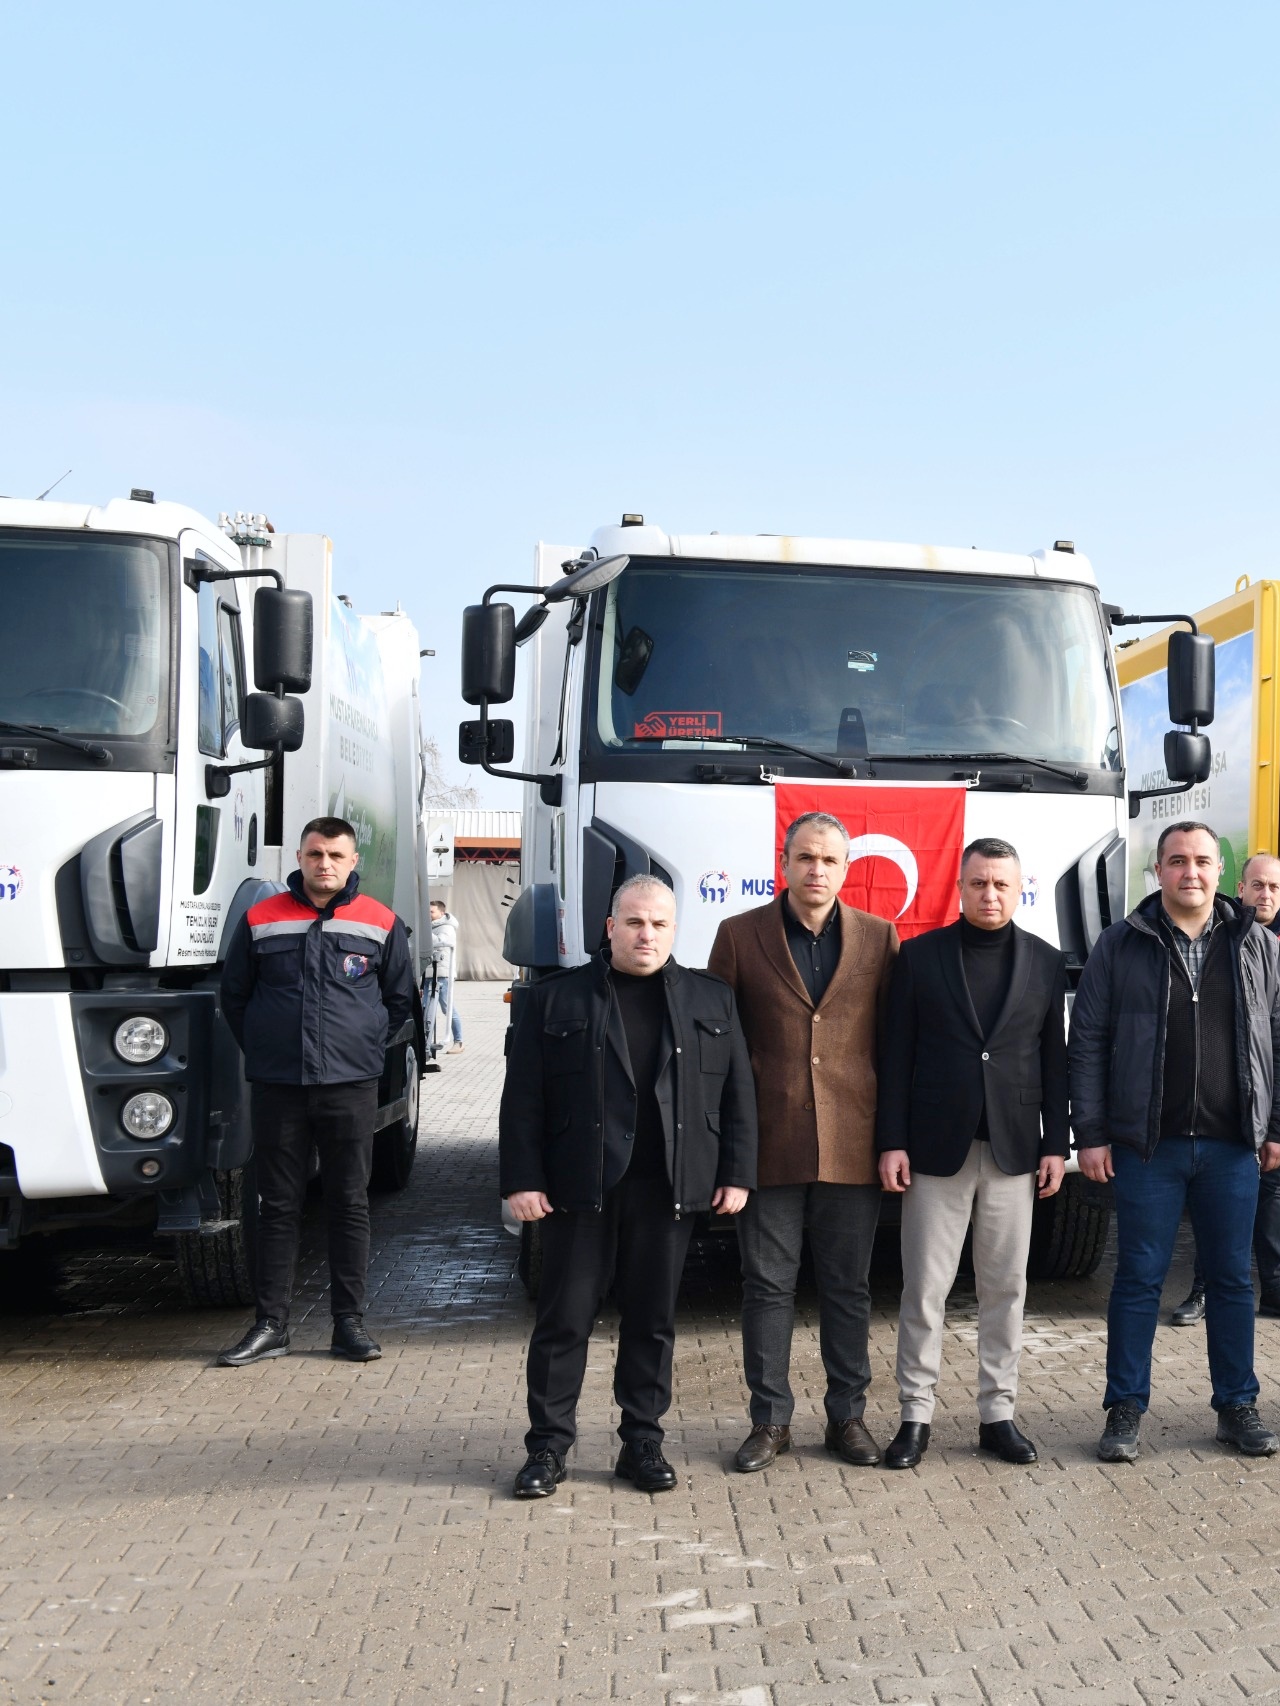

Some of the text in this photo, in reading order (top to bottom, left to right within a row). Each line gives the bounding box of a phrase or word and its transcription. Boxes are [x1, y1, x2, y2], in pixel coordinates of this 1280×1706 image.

[669, 715, 706, 726] YERLİ
[669, 727, 717, 737] ÜRETİM
[1152, 787, 1211, 819] BELEDİYESİ
[741, 879, 775, 896] MUS
